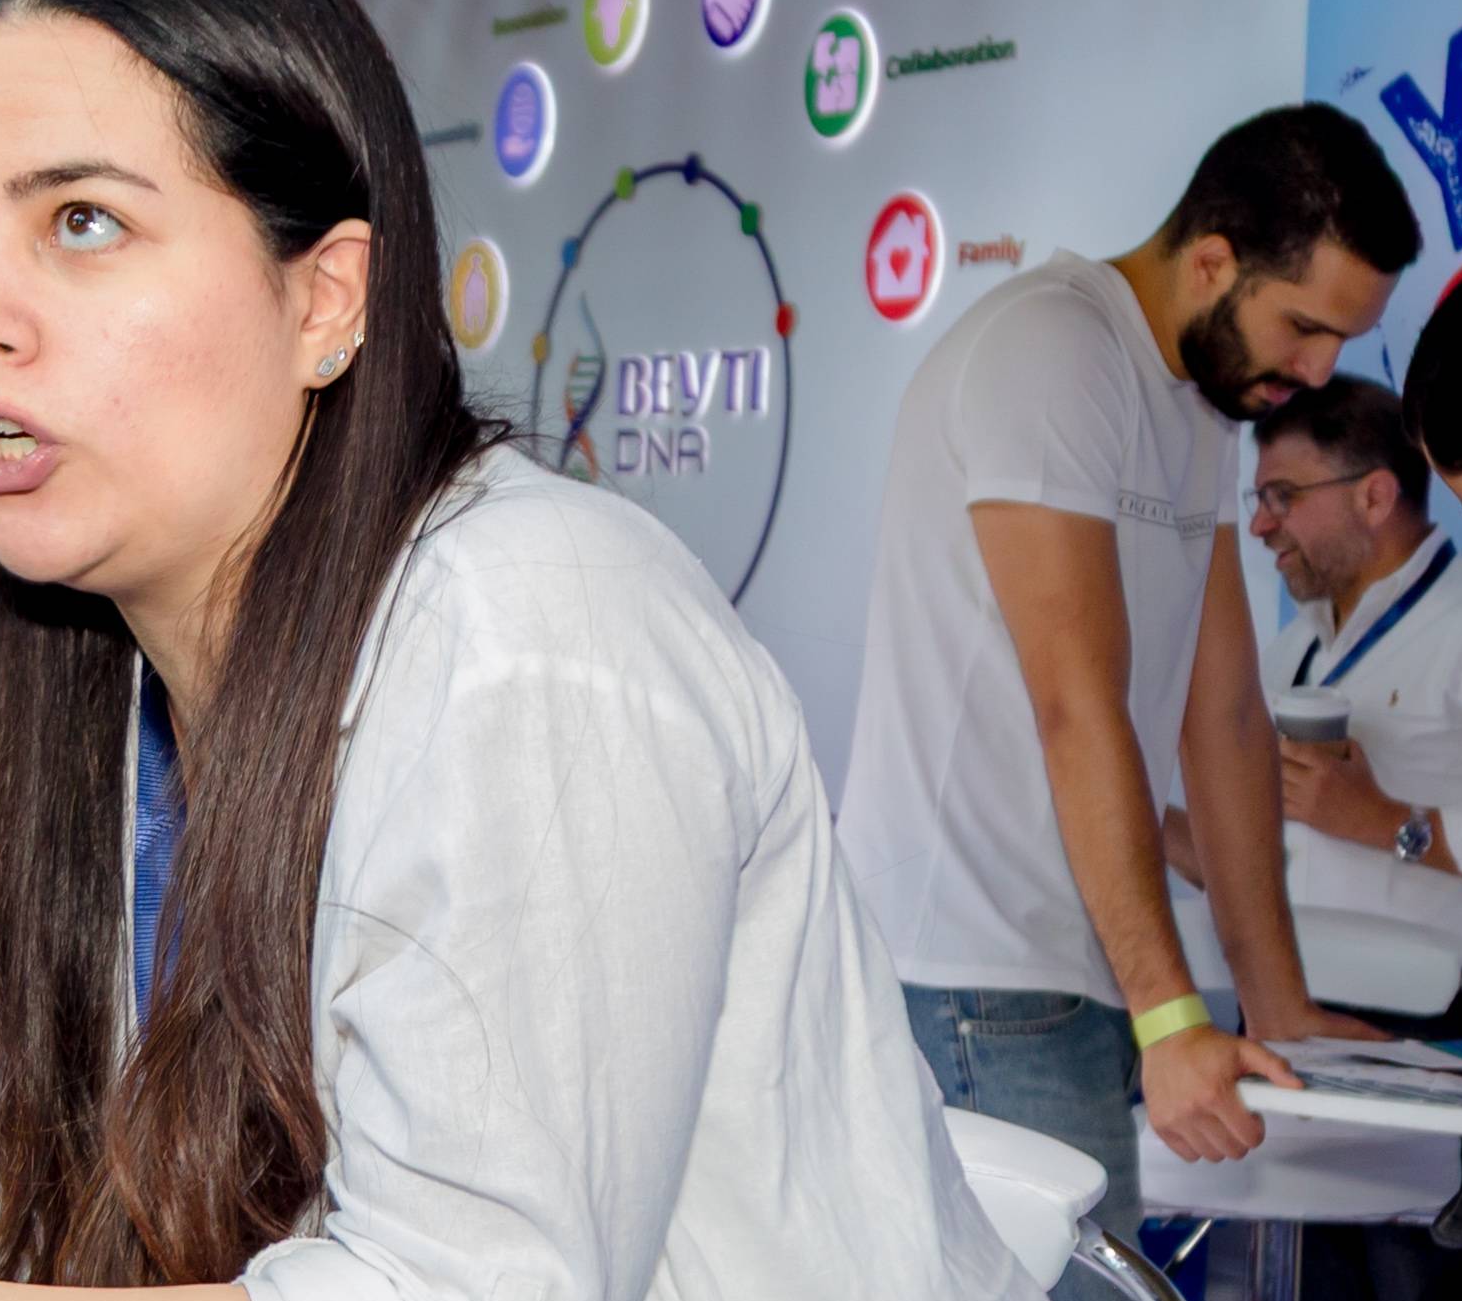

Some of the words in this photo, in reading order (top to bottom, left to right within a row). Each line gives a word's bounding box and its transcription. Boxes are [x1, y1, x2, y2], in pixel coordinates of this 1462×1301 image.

[886, 35, 1017, 79] Collaboration
[957, 233, 1026, 269] Family
[617, 346, 771, 419] BEYTI
[615, 425, 710, 476] DNA
